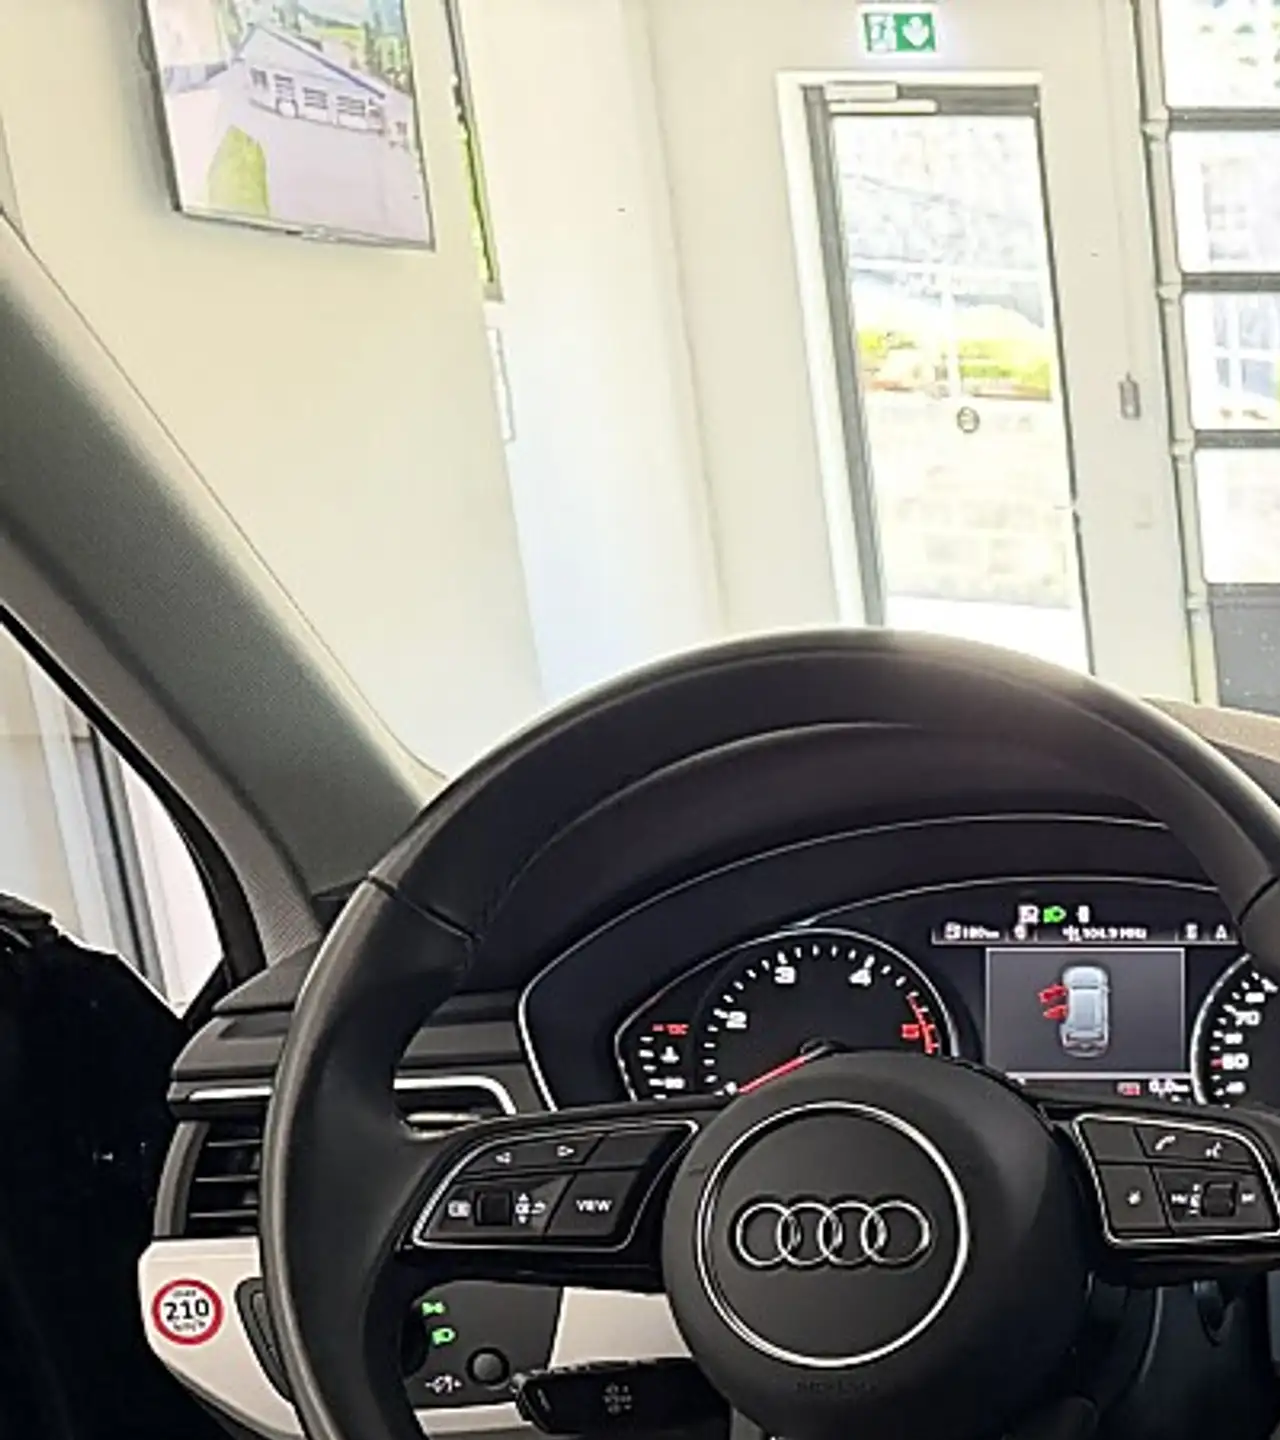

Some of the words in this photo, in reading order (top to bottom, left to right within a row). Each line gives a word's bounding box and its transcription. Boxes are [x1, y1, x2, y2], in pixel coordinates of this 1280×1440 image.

[849, 966, 872, 986] 4
[726, 1011, 747, 1029] 2
[576, 1199, 612, 1212] VIEW
[163, 1298, 210, 1322] 210
